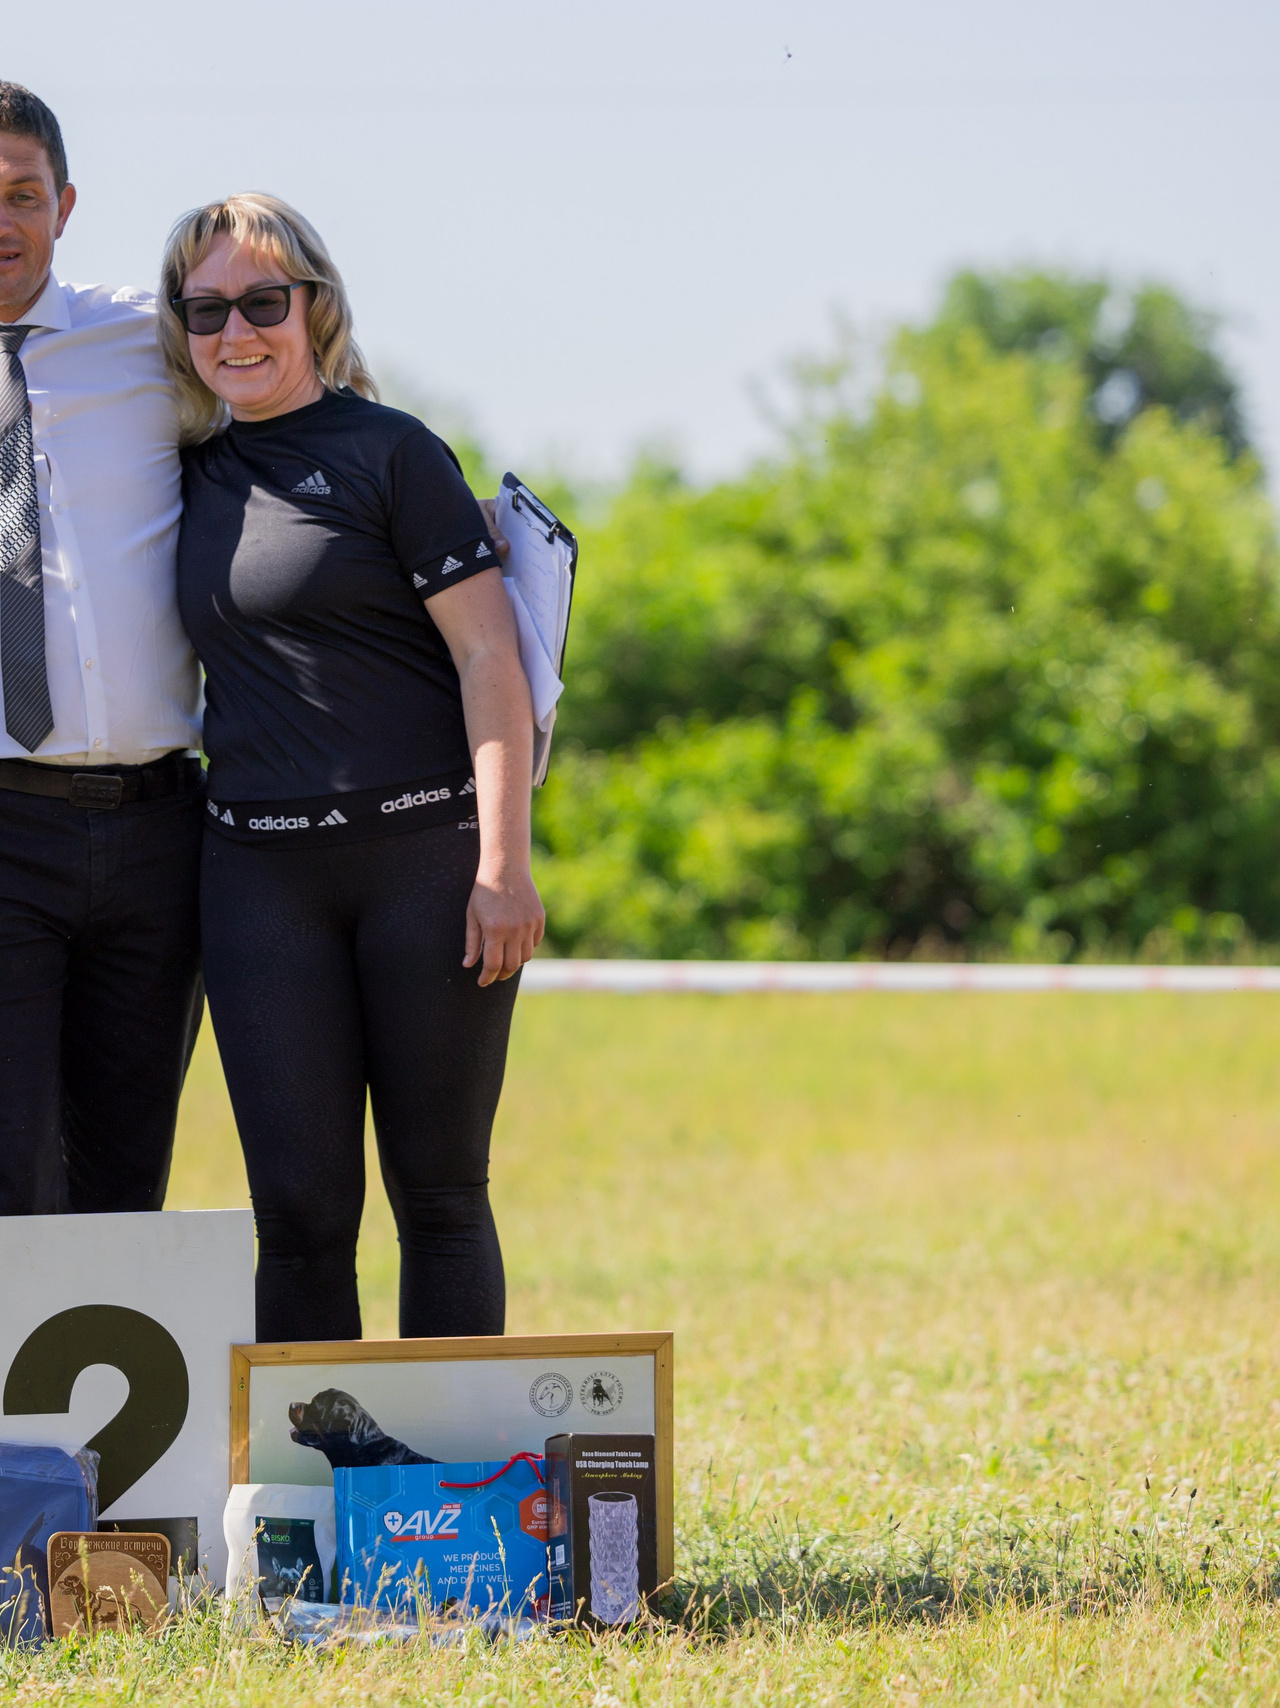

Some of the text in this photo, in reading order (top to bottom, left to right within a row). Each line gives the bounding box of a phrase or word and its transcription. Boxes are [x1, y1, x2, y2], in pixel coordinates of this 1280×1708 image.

[291, 485, 331, 495] adidas
[475, 549, 492, 559] adidas
[441, 561, 464, 575] adidas
[248, 787, 452, 831] adidas adidas
[3, 1303, 198, 1576] 2
[575, 1460, 649, 1469] USB Charging Touch Lamp
[620, 1472, 643, 1480] Making
[395, 1508, 462, 1536] AVZ
[271, 1534, 291, 1542] BISKO
[60, 1537, 162, 1552] Ворежские встречи
[443, 1552, 506, 1562] WE PRODUC
[450, 1563, 501, 1573] MEDCINES
[437, 1576, 458, 1585] AND
[476, 1575, 485, 1583] IT
